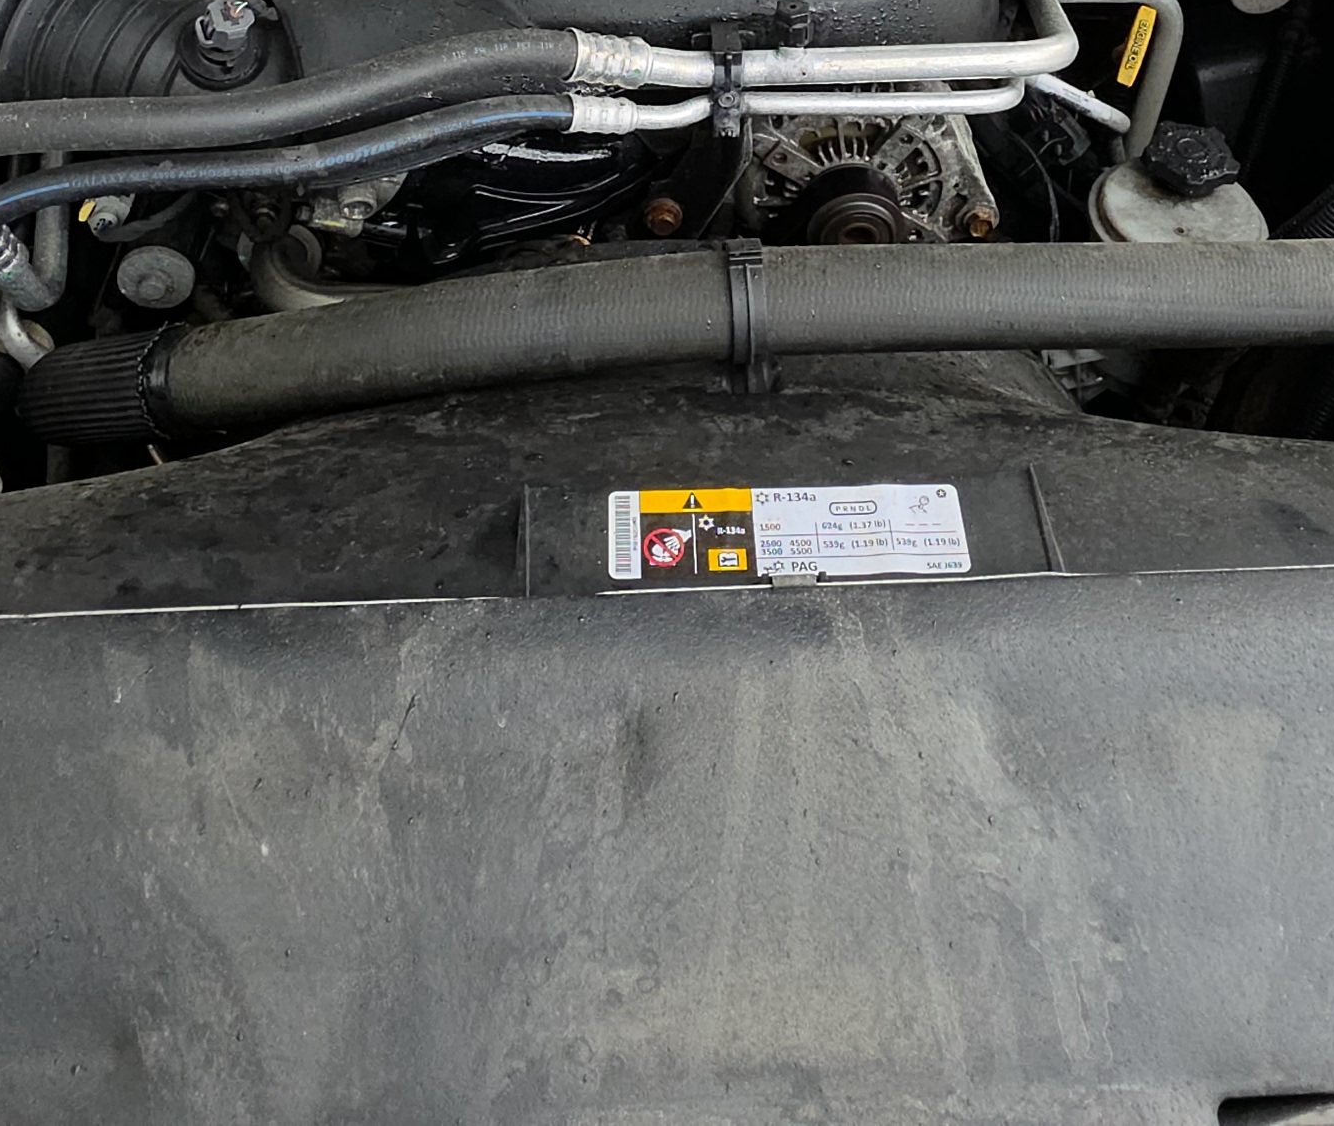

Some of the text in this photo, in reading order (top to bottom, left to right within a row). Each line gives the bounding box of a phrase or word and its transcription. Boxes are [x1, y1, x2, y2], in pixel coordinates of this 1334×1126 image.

[1124, 19, 1149, 70] ENGINE OIL
[71, 173, 126, 189] GALAXY
[315, 140, 397, 169] GOODYEAR
[773, 492, 817, 502] R-134a
[760, 519, 887, 531] 1500 624g (1.37 lb)
[760, 537, 961, 550] 2500 4500 539g (1.19 lb) 539g (1.19 lb)
[761, 547, 813, 555] 3500 5500
[791, 561, 963, 572] PAG SAE J639
